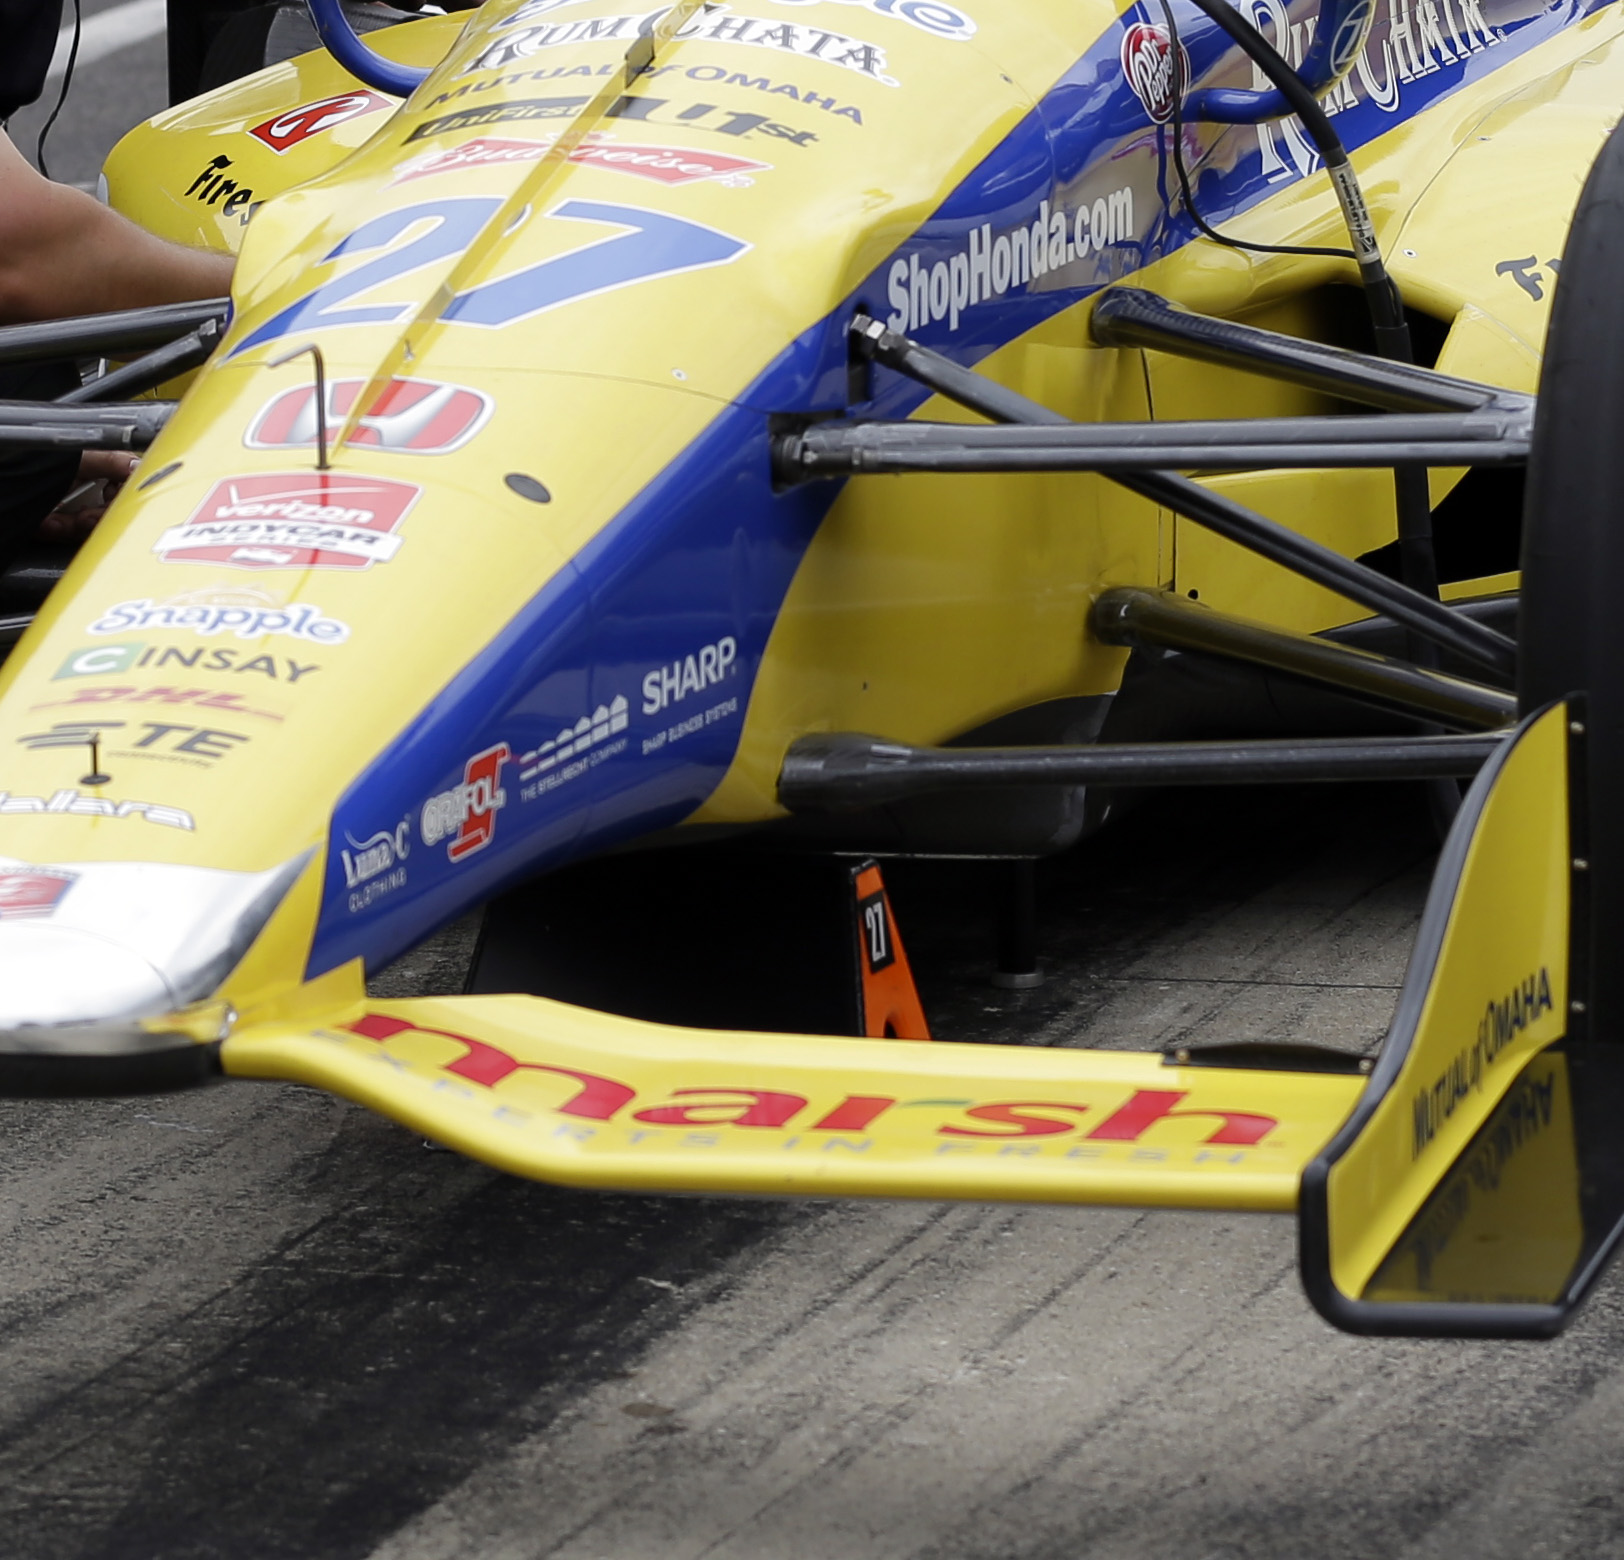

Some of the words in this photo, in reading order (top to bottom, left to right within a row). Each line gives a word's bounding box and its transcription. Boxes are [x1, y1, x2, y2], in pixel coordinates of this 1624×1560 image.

[423, 64, 612, 109] MUTUAL
[686, 64, 864, 124] OMAHA
[1135, 46, 1173, 111] Peppe
[423, 104, 583, 136] UniFirst
[219, 197, 750, 362] 27
[887, 184, 1134, 337] ShopHonda.com
[183, 523, 381, 545] INDYCAR
[215, 500, 375, 524] verizon
[92, 600, 343, 639] Snapple
[70, 687, 249, 712] DHL
[642, 636, 737, 715] SHARP
[134, 723, 250, 758] TE
[348, 867, 407, 913] CLOTHING
[866, 901, 886, 961] 27
[1485, 967, 1552, 1064] OMAHA
[339, 1014, 1279, 1146] marsh
[783, 1136, 876, 1152] IN
[935, 1143, 1247, 1165] FRESH
